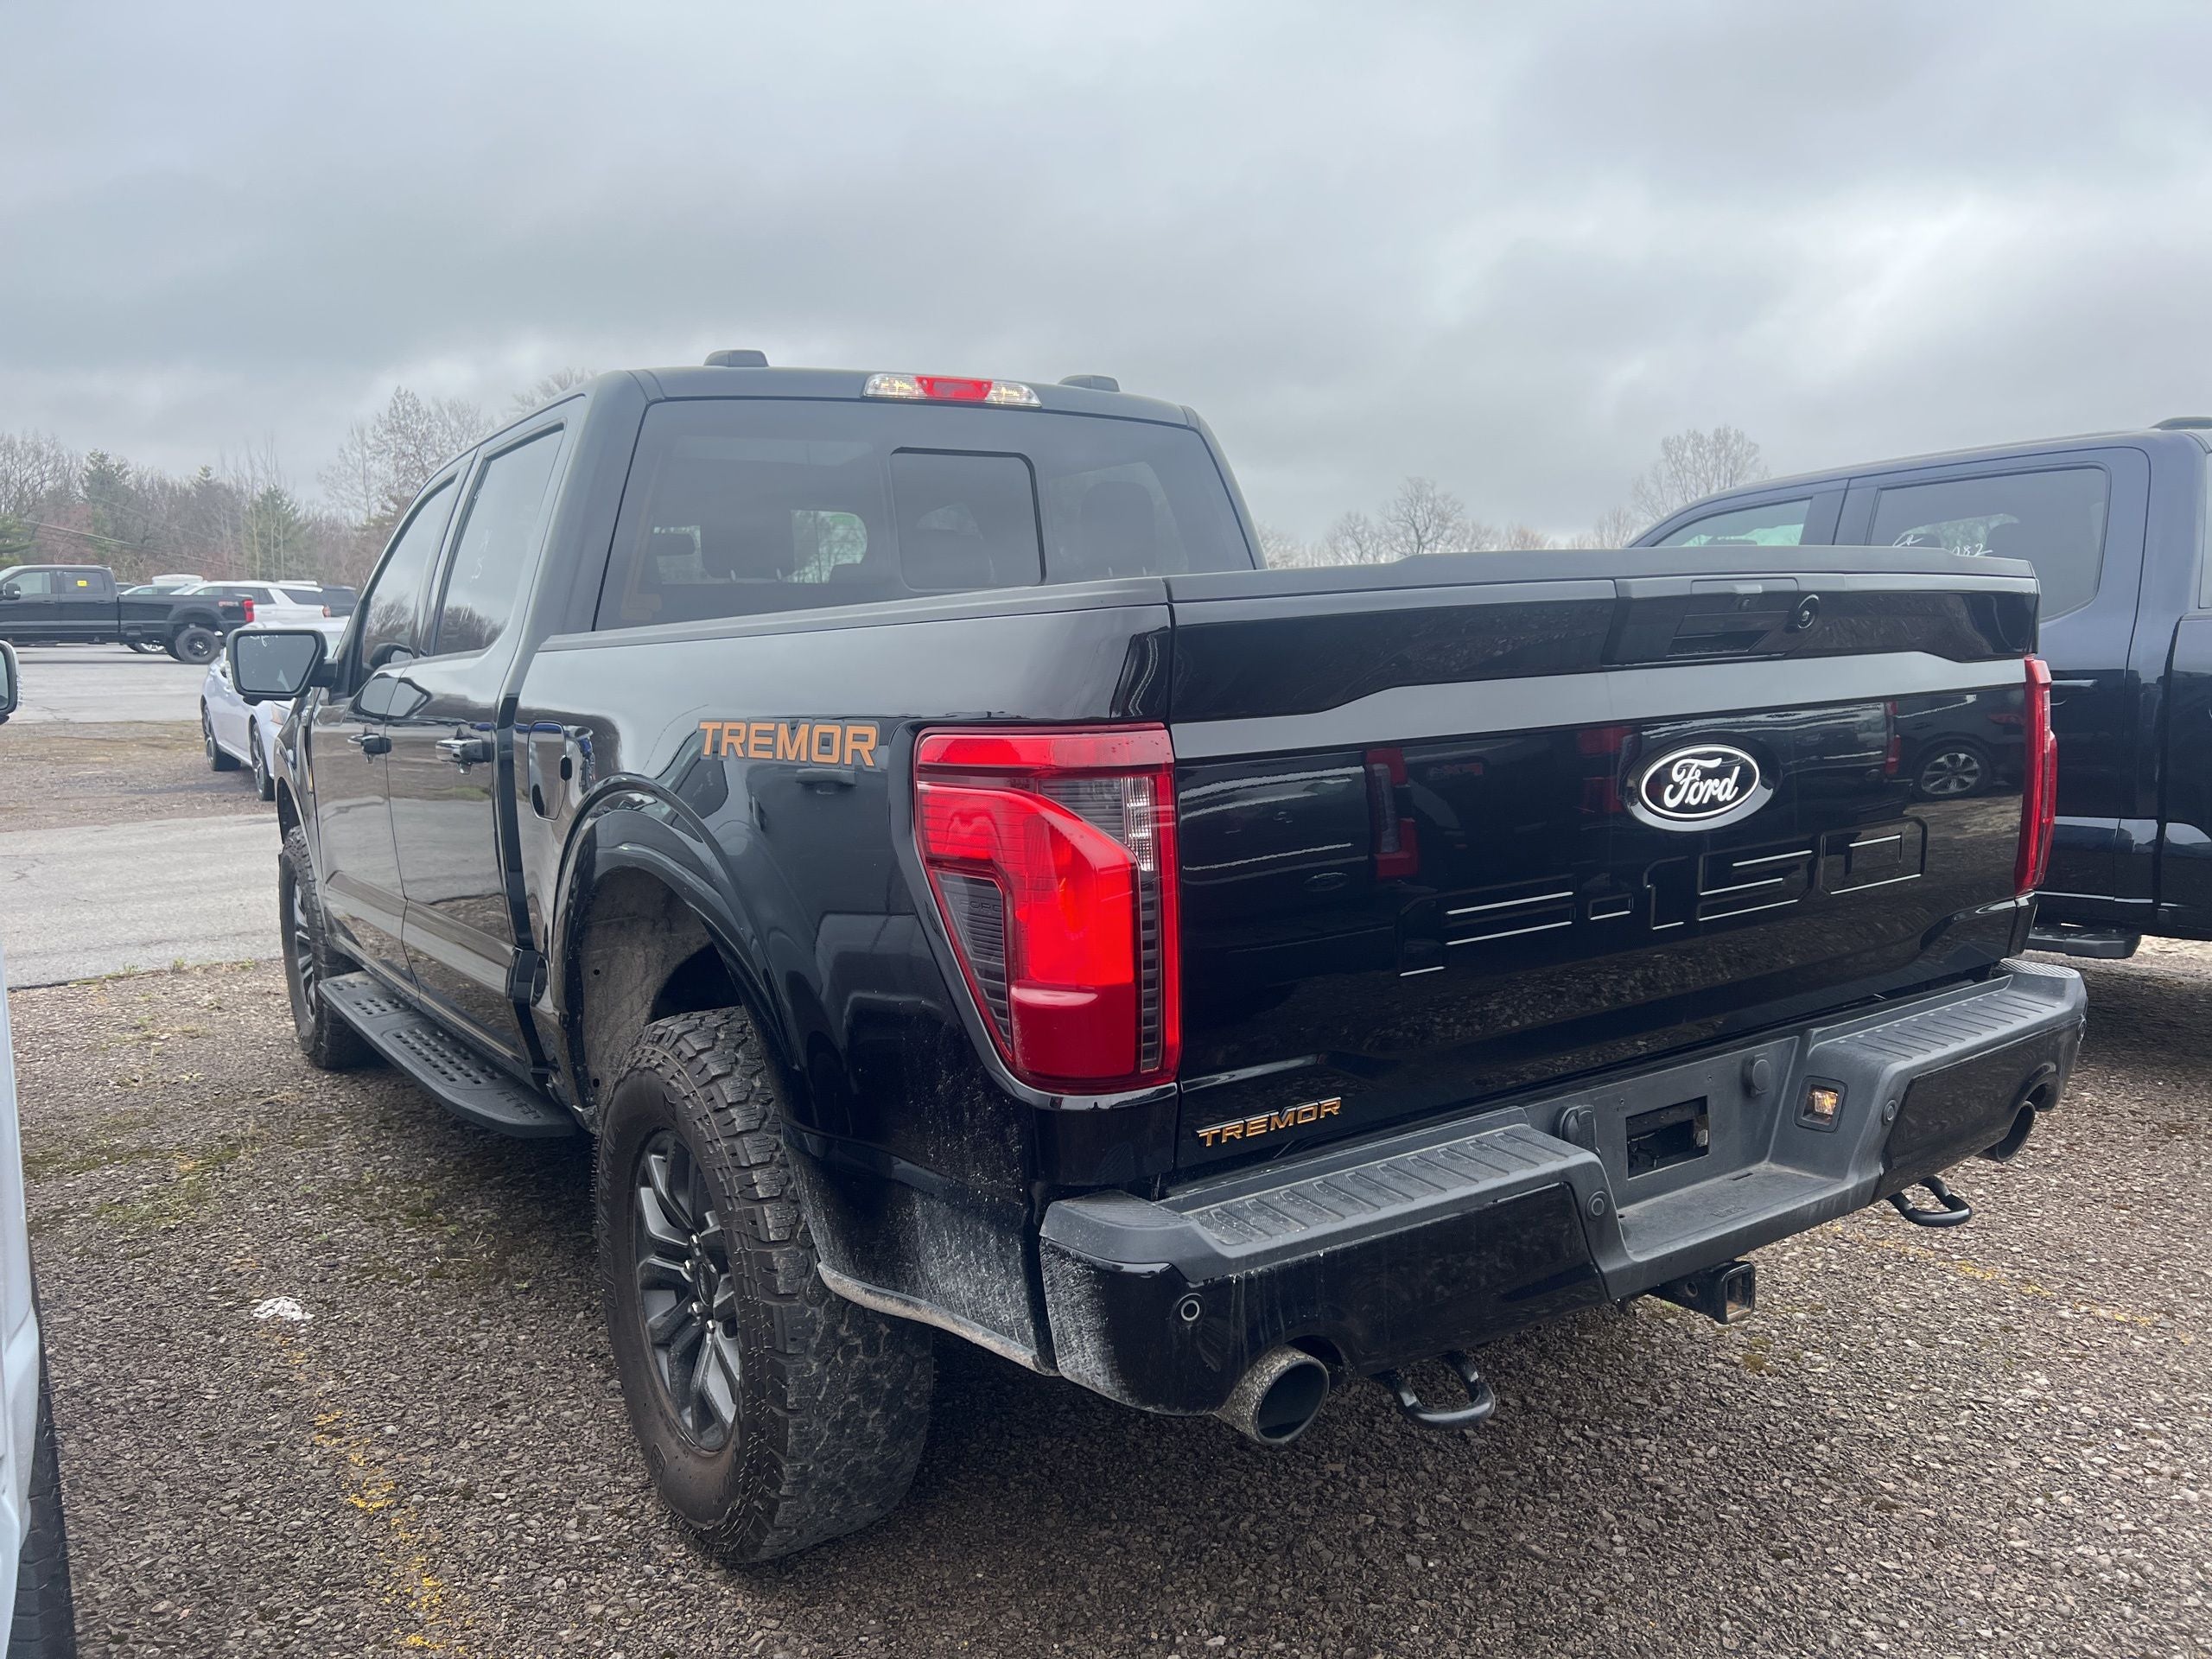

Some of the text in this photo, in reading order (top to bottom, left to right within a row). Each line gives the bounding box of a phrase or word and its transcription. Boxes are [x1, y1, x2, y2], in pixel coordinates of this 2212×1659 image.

[699, 721, 877, 767] TREMOR
[1663, 757, 1740, 808] Ford
[1398, 816, 1928, 976] F-150
[1197, 1096, 1342, 1147] TREMOR
